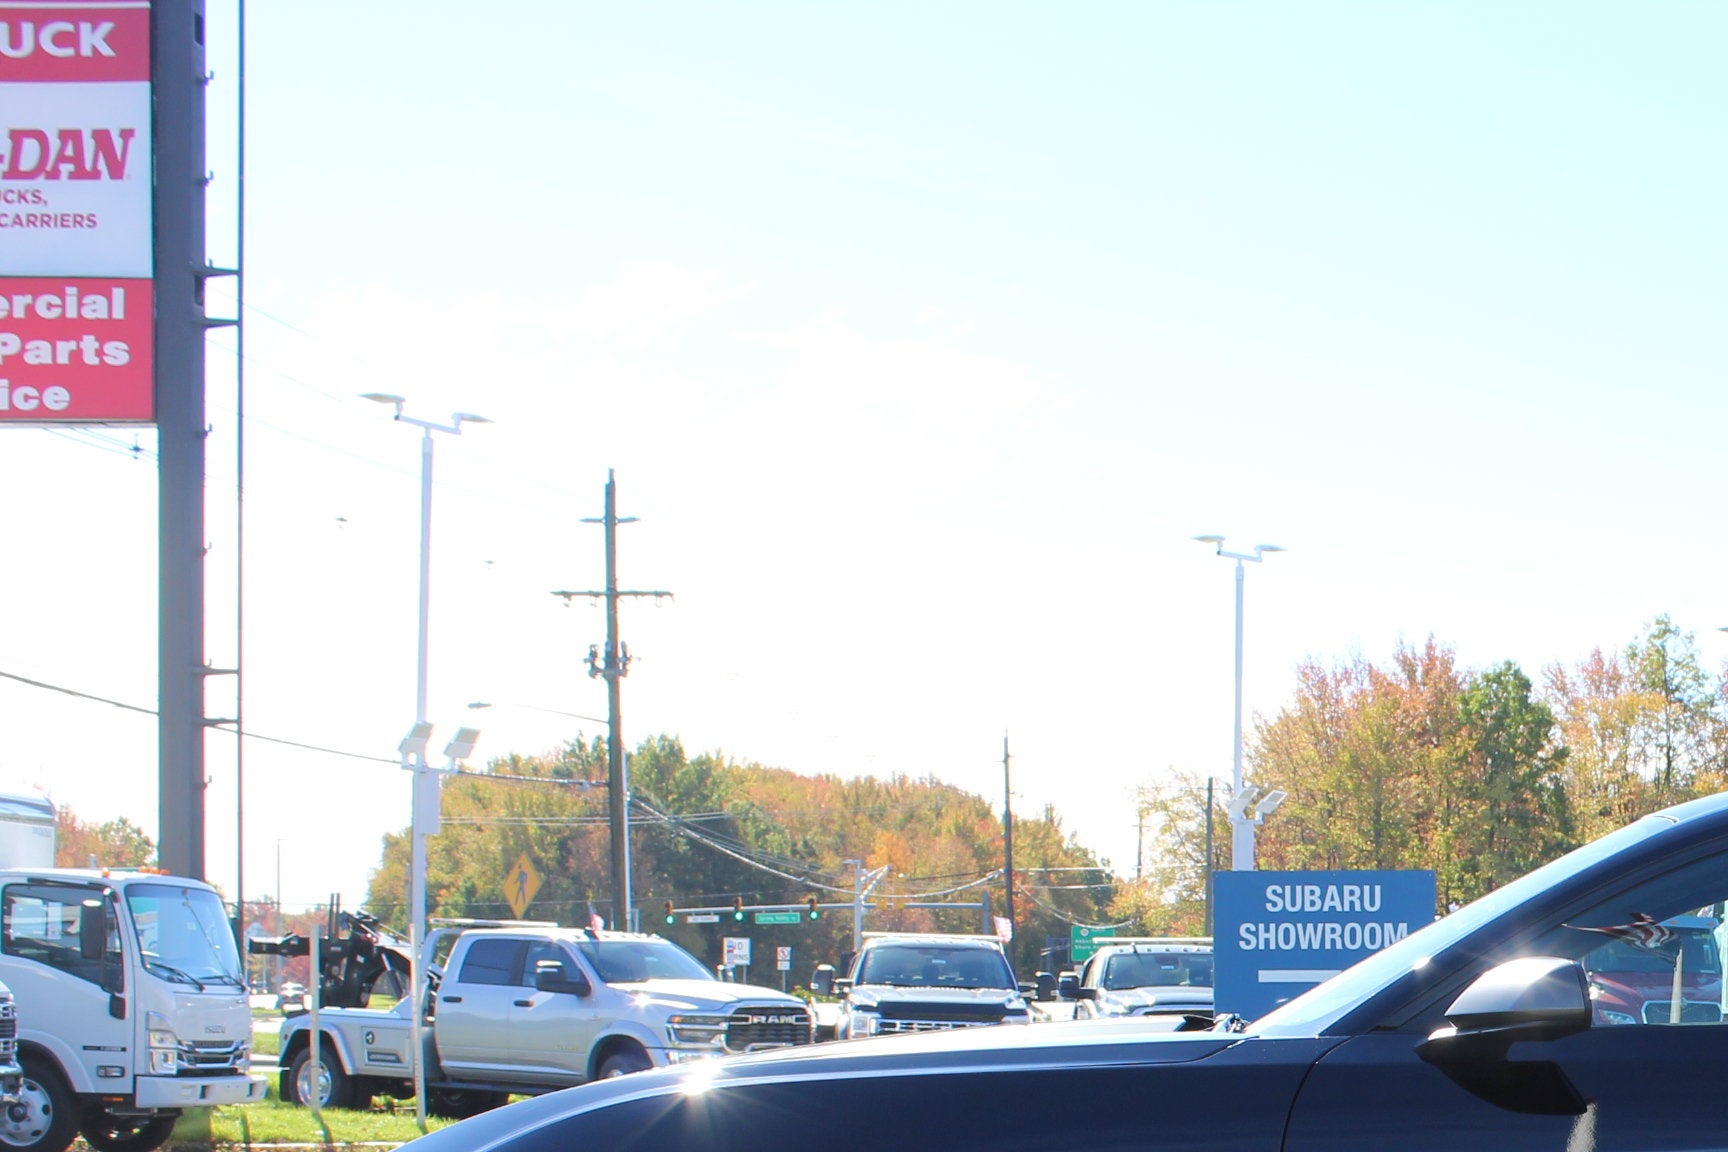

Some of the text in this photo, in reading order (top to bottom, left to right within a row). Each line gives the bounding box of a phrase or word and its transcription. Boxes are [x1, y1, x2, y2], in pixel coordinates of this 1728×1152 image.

[0, 21, 117, 58] UCK
[0, 189, 48, 206] CKS,
[0, 213, 98, 229] CARRIERS
[0, 332, 131, 366] Parts
[1265, 884, 1381, 912] SUBARU
[1239, 923, 1407, 950] SHOWROOM
[752, 1015, 793, 1024] RAM
